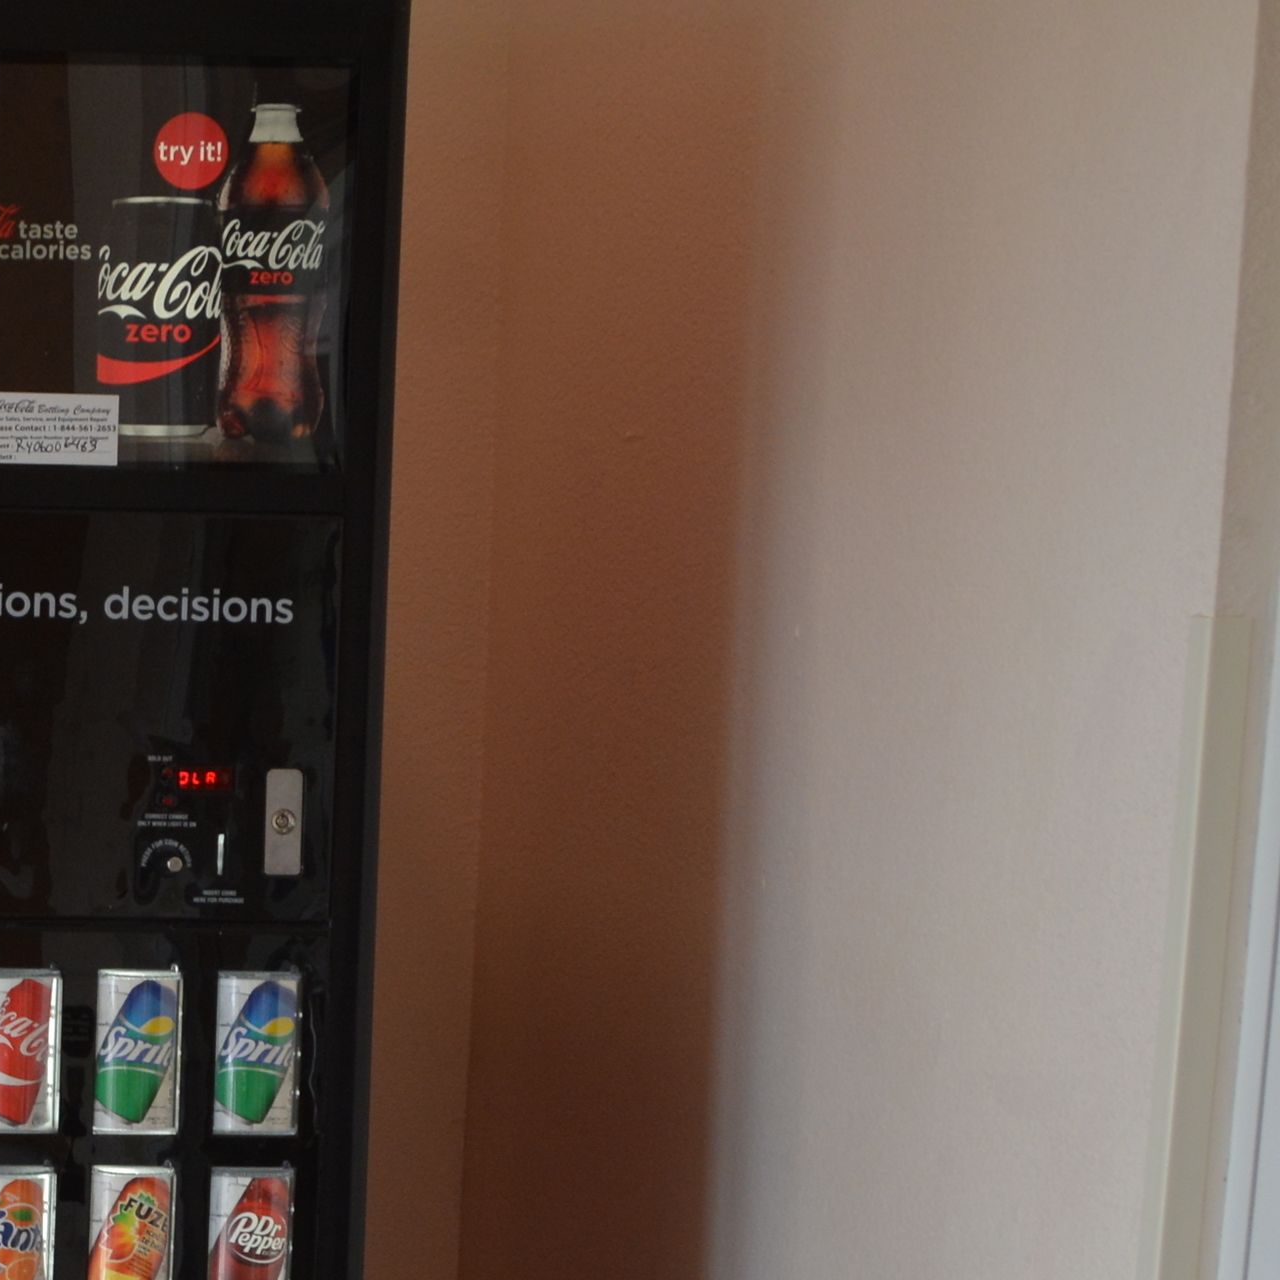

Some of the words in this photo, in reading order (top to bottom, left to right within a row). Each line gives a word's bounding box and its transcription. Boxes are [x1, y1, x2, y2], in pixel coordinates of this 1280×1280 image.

[158, 142, 193, 165] try
[199, 141, 222, 162] it!
[19, 220, 78, 240] taste
[250, 271, 293, 285] zero
[126, 323, 192, 343] zero
[104, 585, 294, 624] decisions
[100, 1026, 173, 1066] Sprit
[229, 1211, 286, 1255] Pepper
[254, 1216, 282, 1237] Dr
